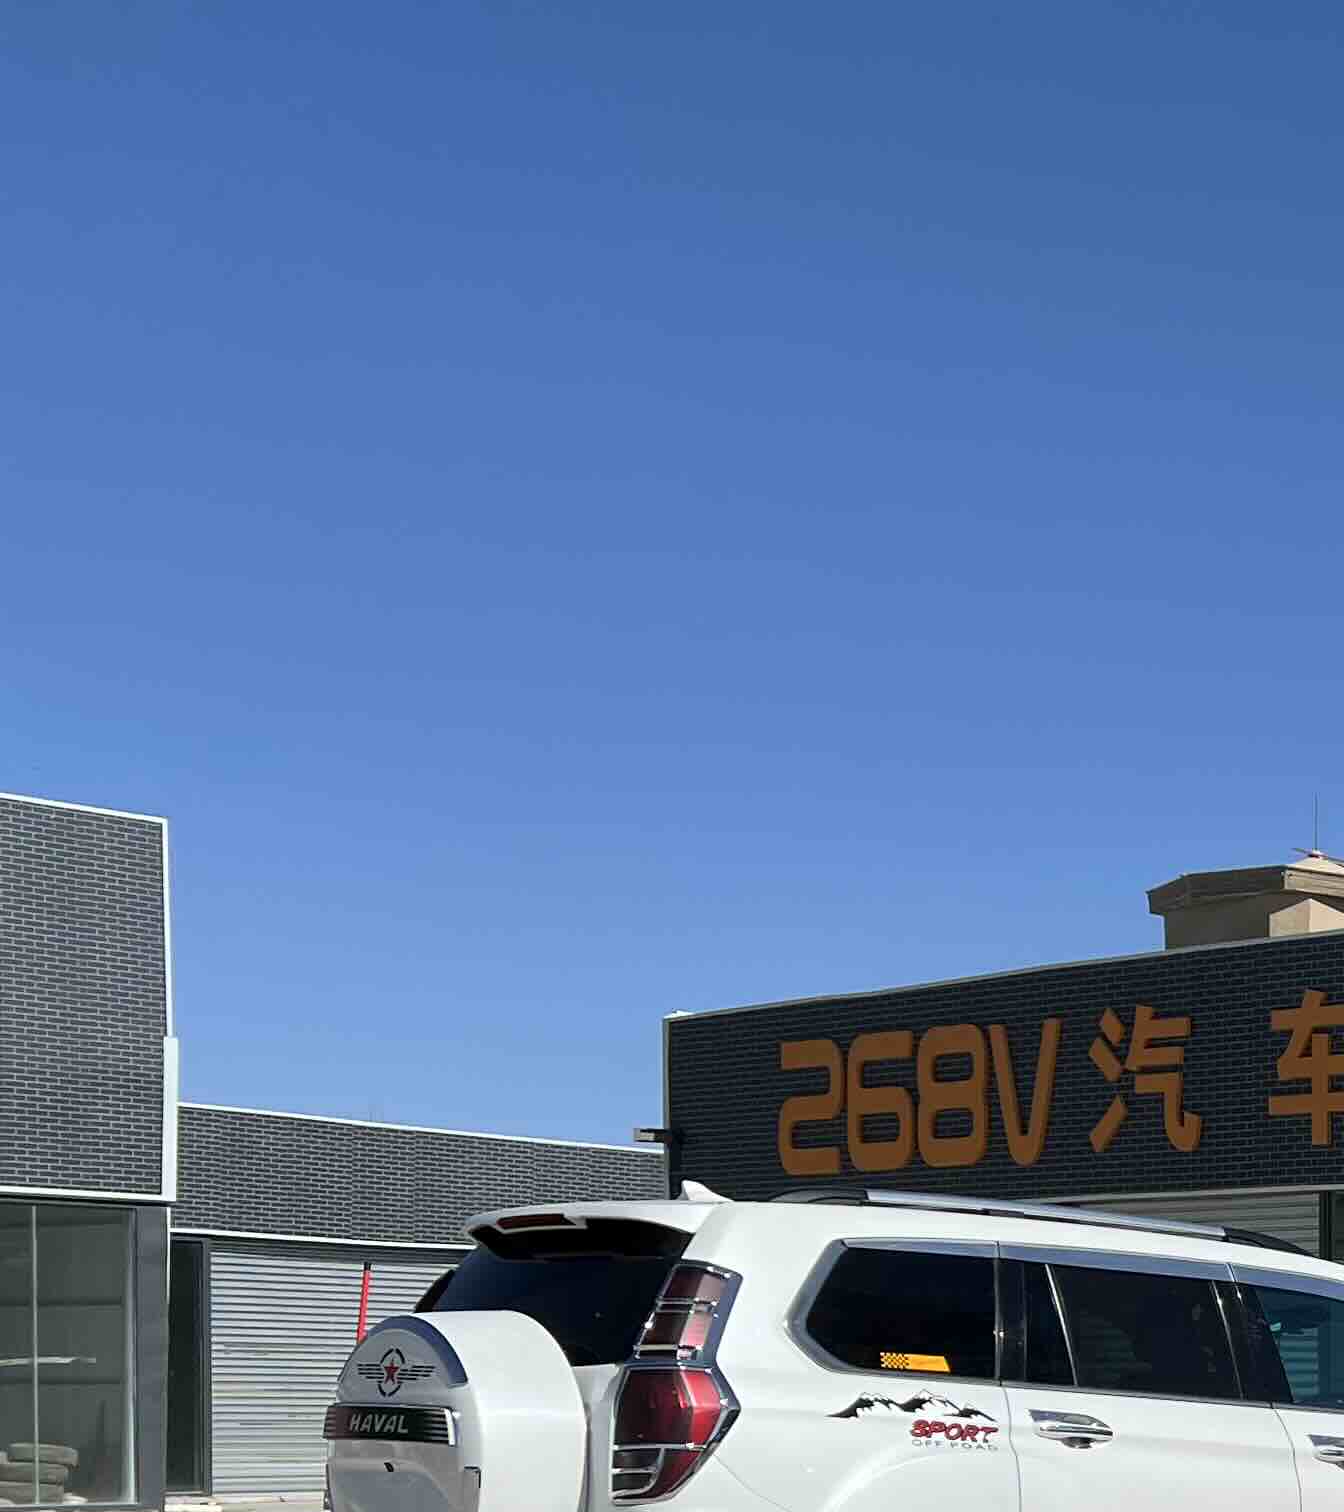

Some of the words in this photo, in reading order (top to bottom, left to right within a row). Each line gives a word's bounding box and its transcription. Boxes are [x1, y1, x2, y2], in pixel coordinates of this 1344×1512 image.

[348, 1413, 409, 1434] HAVAL
[910, 1418, 999, 1444] SPORT
[911, 1439, 944, 1448] OFF
